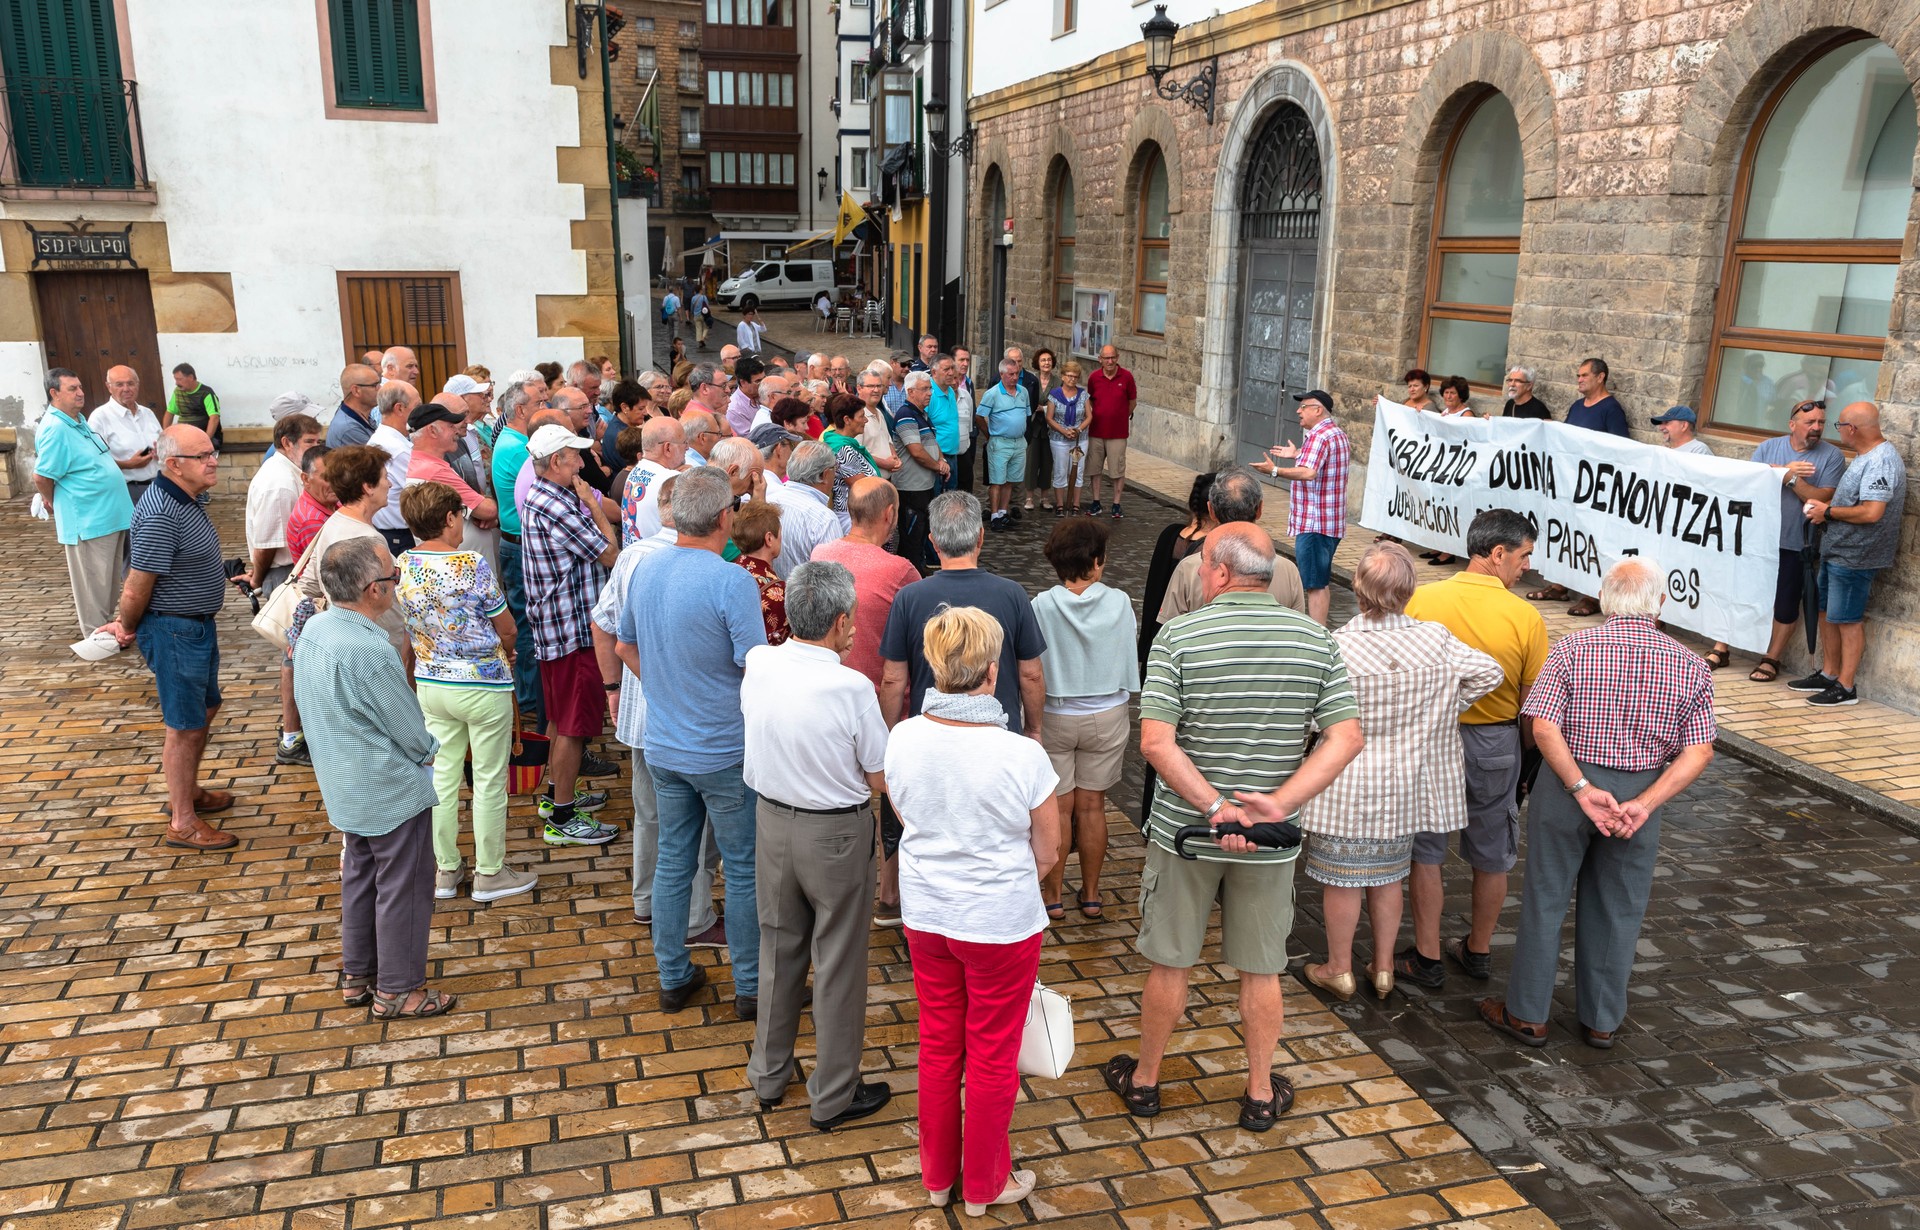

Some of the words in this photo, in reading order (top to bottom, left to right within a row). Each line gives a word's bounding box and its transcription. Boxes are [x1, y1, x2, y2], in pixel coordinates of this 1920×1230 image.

[67, 238, 123, 254] PULPO
[1573, 459, 1753, 557] DENONTZAT
[1547, 518, 1602, 578] PARA
